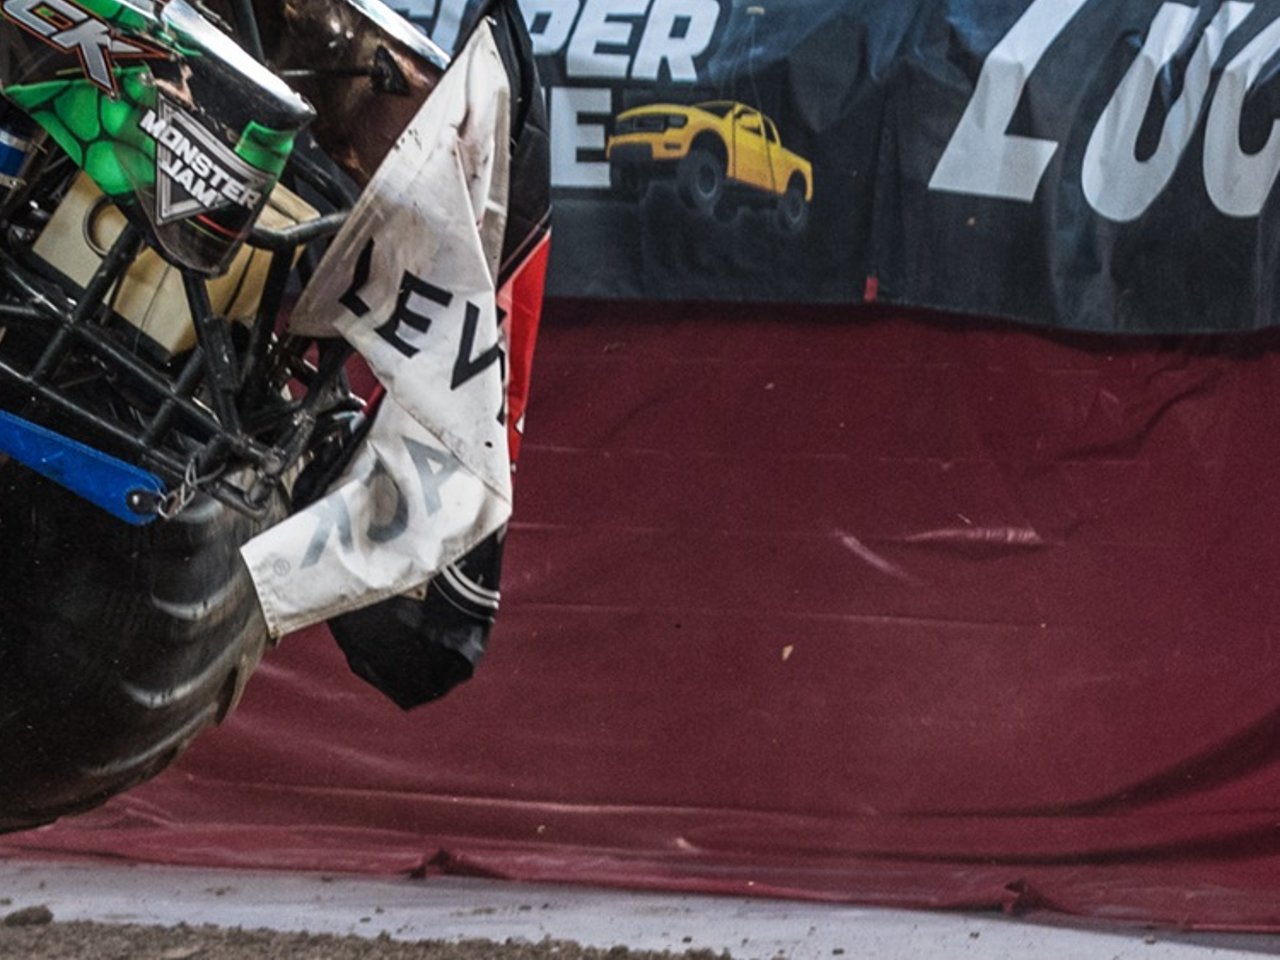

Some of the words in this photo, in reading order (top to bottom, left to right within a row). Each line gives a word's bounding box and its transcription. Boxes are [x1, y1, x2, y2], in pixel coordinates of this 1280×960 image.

[140, 109, 262, 209] MONSTER
[159, 159, 218, 208] JAM
[338, 237, 506, 426] LEV
